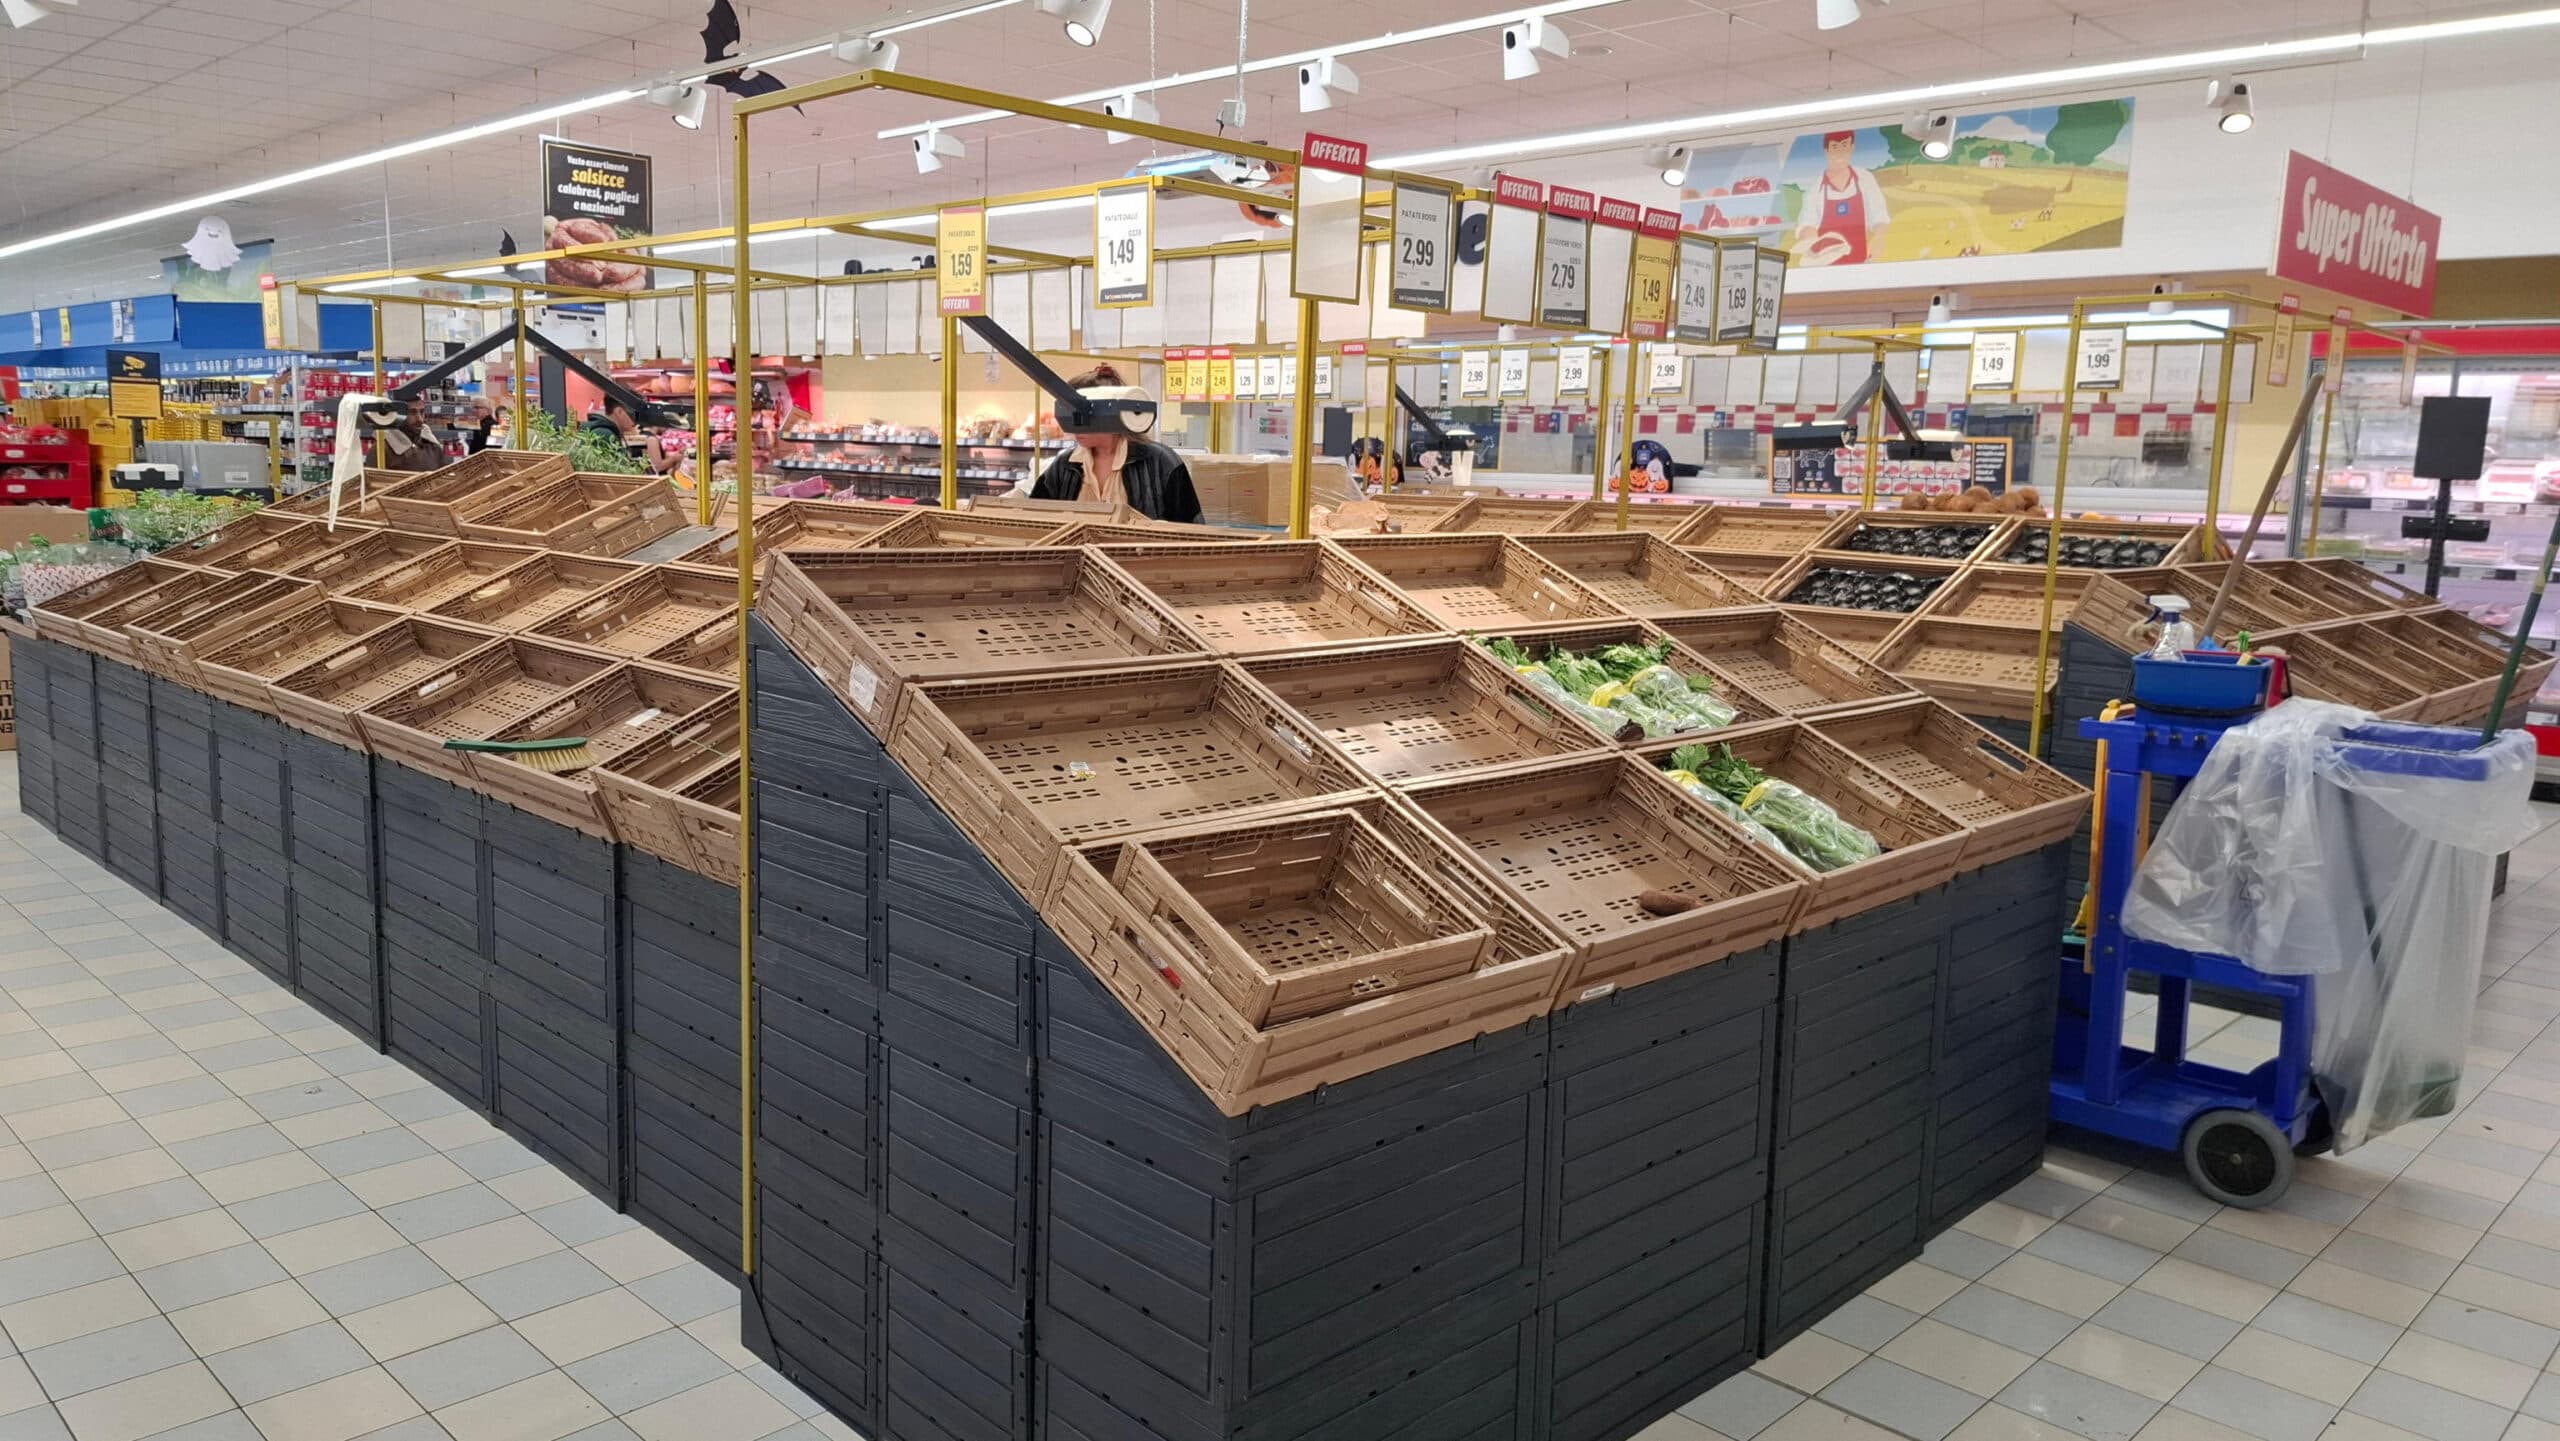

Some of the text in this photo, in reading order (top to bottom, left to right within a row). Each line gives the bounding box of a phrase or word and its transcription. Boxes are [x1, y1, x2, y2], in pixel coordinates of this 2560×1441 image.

[1310, 140, 1360, 165] OFFERTA
[571, 167, 625, 189] salsicce
[557, 183, 639, 204] calabresi, pugliesi
[1501, 180, 1539, 202] OFFERTA
[1553, 191, 1591, 212] OFFERTA
[573, 200, 580, 211] e
[1602, 202, 1637, 222] OFFERTA
[1646, 212, 1678, 231] OFFERTA
[2296, 176, 2427, 289] Super Offerta
[1109, 238, 1135, 267] 1,49
[1402, 237, 1434, 268] 2,99
[951, 253, 972, 278] 1,59
[1551, 263, 1576, 290] 2,79
[1642, 278, 1661, 304] 1,49
[1685, 283, 1705, 308] 2,49
[1727, 287, 1746, 311] 1,69
[943, 297, 970, 310] OFFERTA
[1755, 296, 1774, 319] 2,99
[1632, 321, 1655, 335] OFFERTA
[1981, 357, 2004, 372] 1,49
[2087, 354, 2110, 369] 1,99
